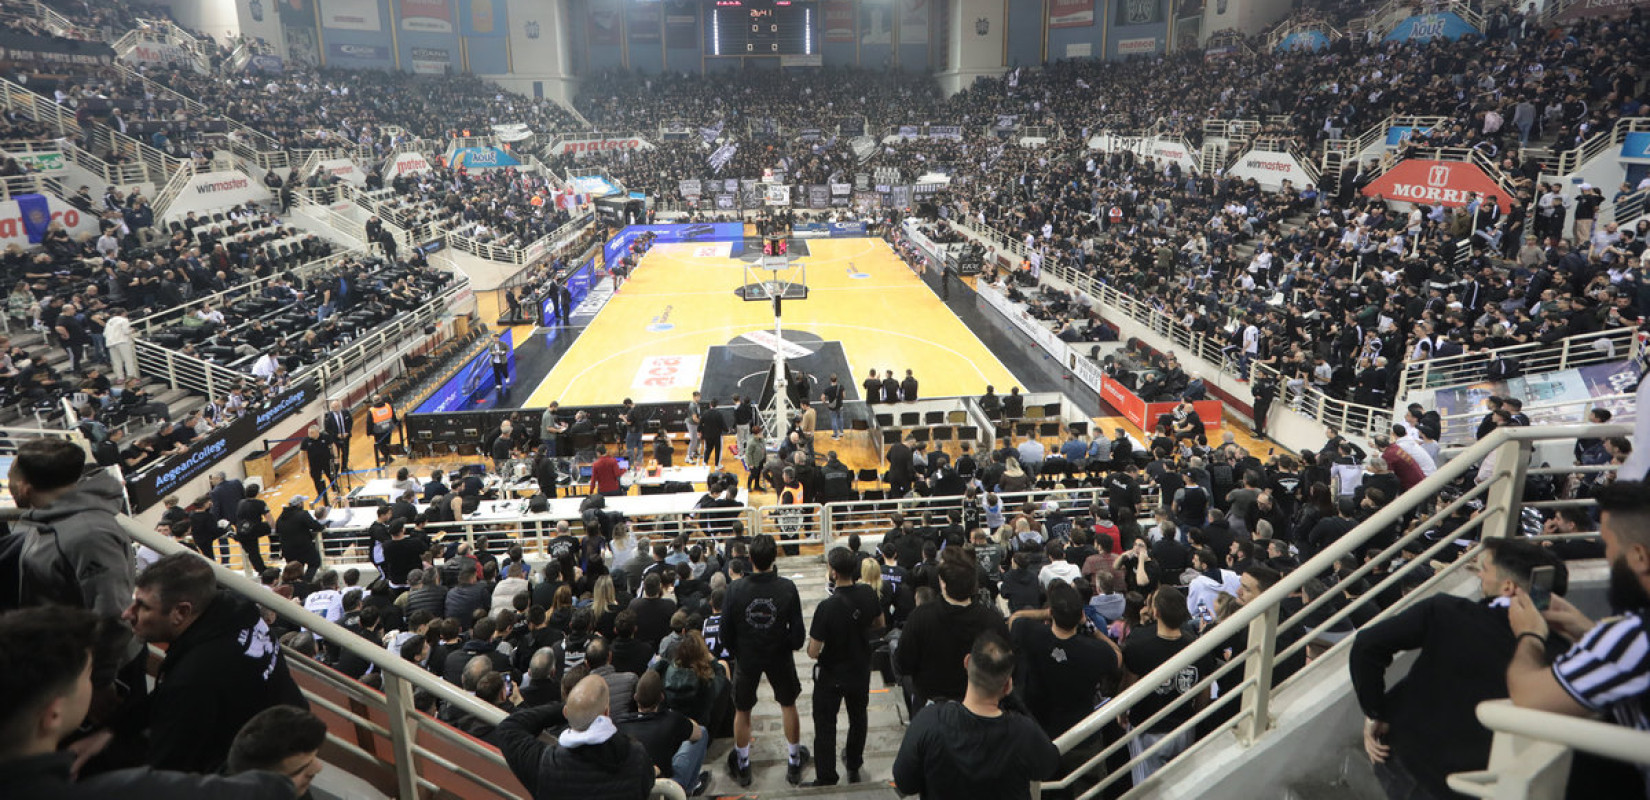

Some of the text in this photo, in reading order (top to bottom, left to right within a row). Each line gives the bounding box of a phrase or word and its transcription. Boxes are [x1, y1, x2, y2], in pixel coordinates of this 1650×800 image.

[564, 139, 639, 155] mateco
[396, 158, 427, 174] mateco
[1246, 159, 1292, 173] winmasters
[196, 178, 248, 194] winmasters
[155, 438, 227, 488] AegeanCollege
